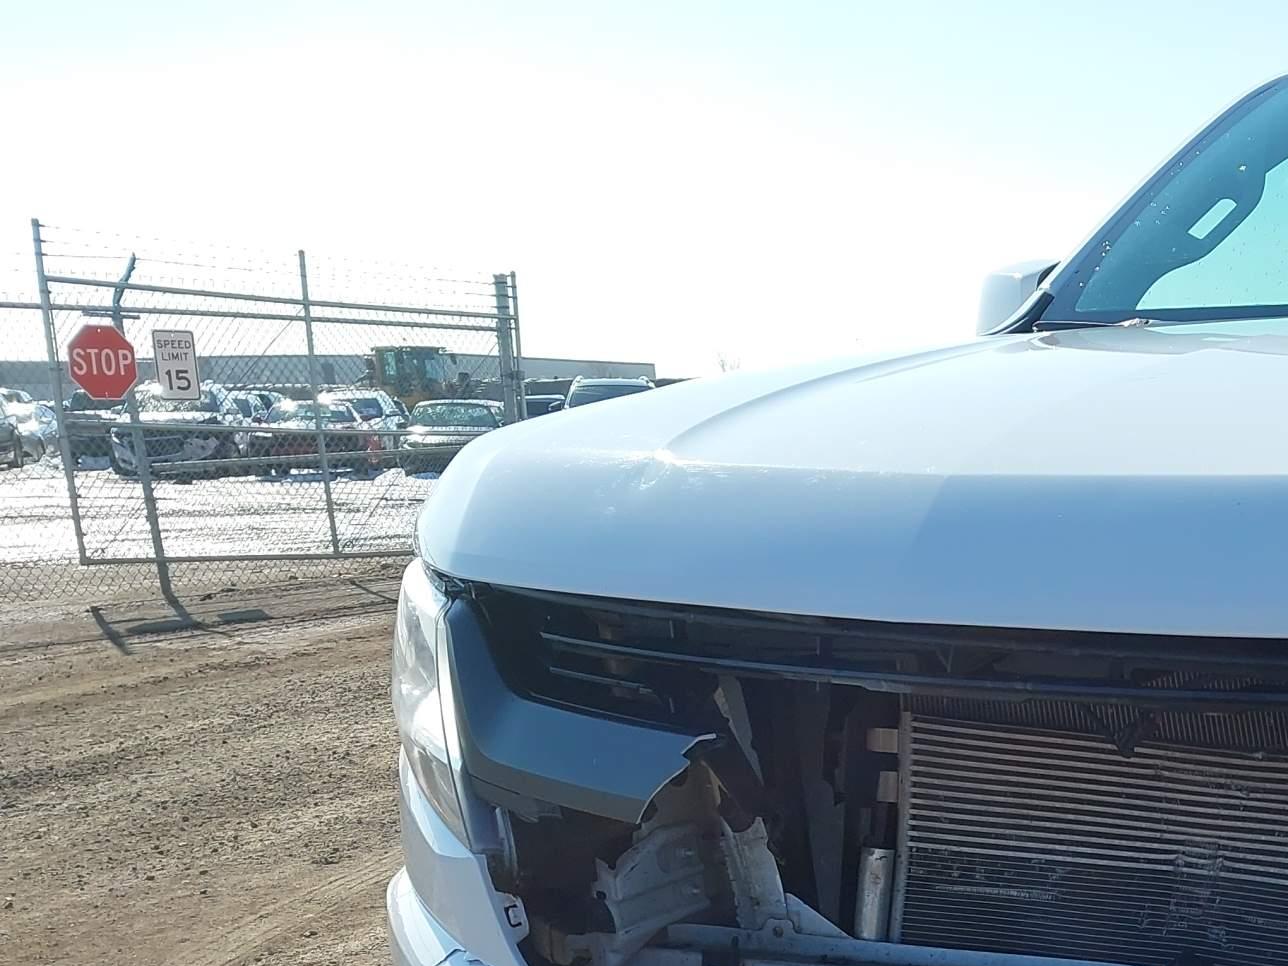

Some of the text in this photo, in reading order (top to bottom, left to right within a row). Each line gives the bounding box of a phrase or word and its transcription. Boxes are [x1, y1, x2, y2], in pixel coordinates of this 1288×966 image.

[156, 339, 192, 350] SPEED
[72, 347, 132, 376] STOP
[161, 351, 189, 361] LIMIT
[165, 369, 192, 391] 15
